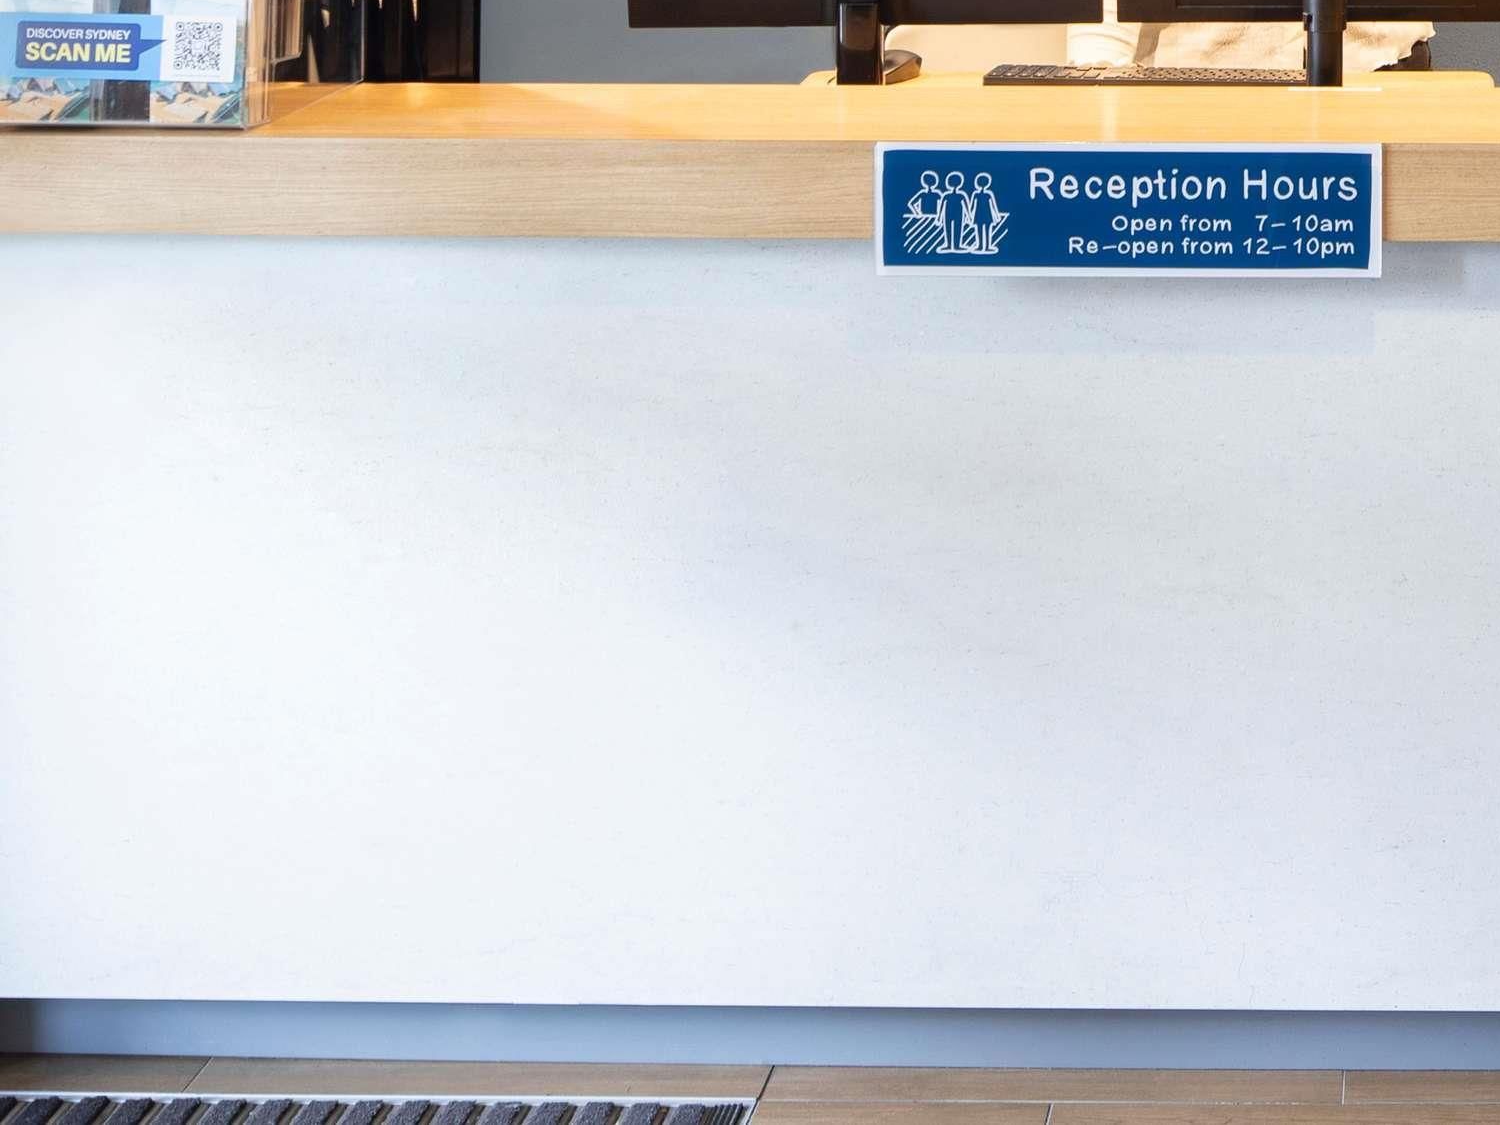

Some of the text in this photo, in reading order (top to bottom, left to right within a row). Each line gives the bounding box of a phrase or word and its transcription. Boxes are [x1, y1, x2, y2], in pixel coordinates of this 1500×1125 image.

[26, 28, 131, 40] DISCOVER SYDNEY
[25, 42, 132, 63] SCAN ME
[1029, 167, 1358, 209] Reception Hours
[1112, 215, 1173, 236] Open
[1180, 214, 1232, 232] from
[1181, 237, 1234, 255] from
